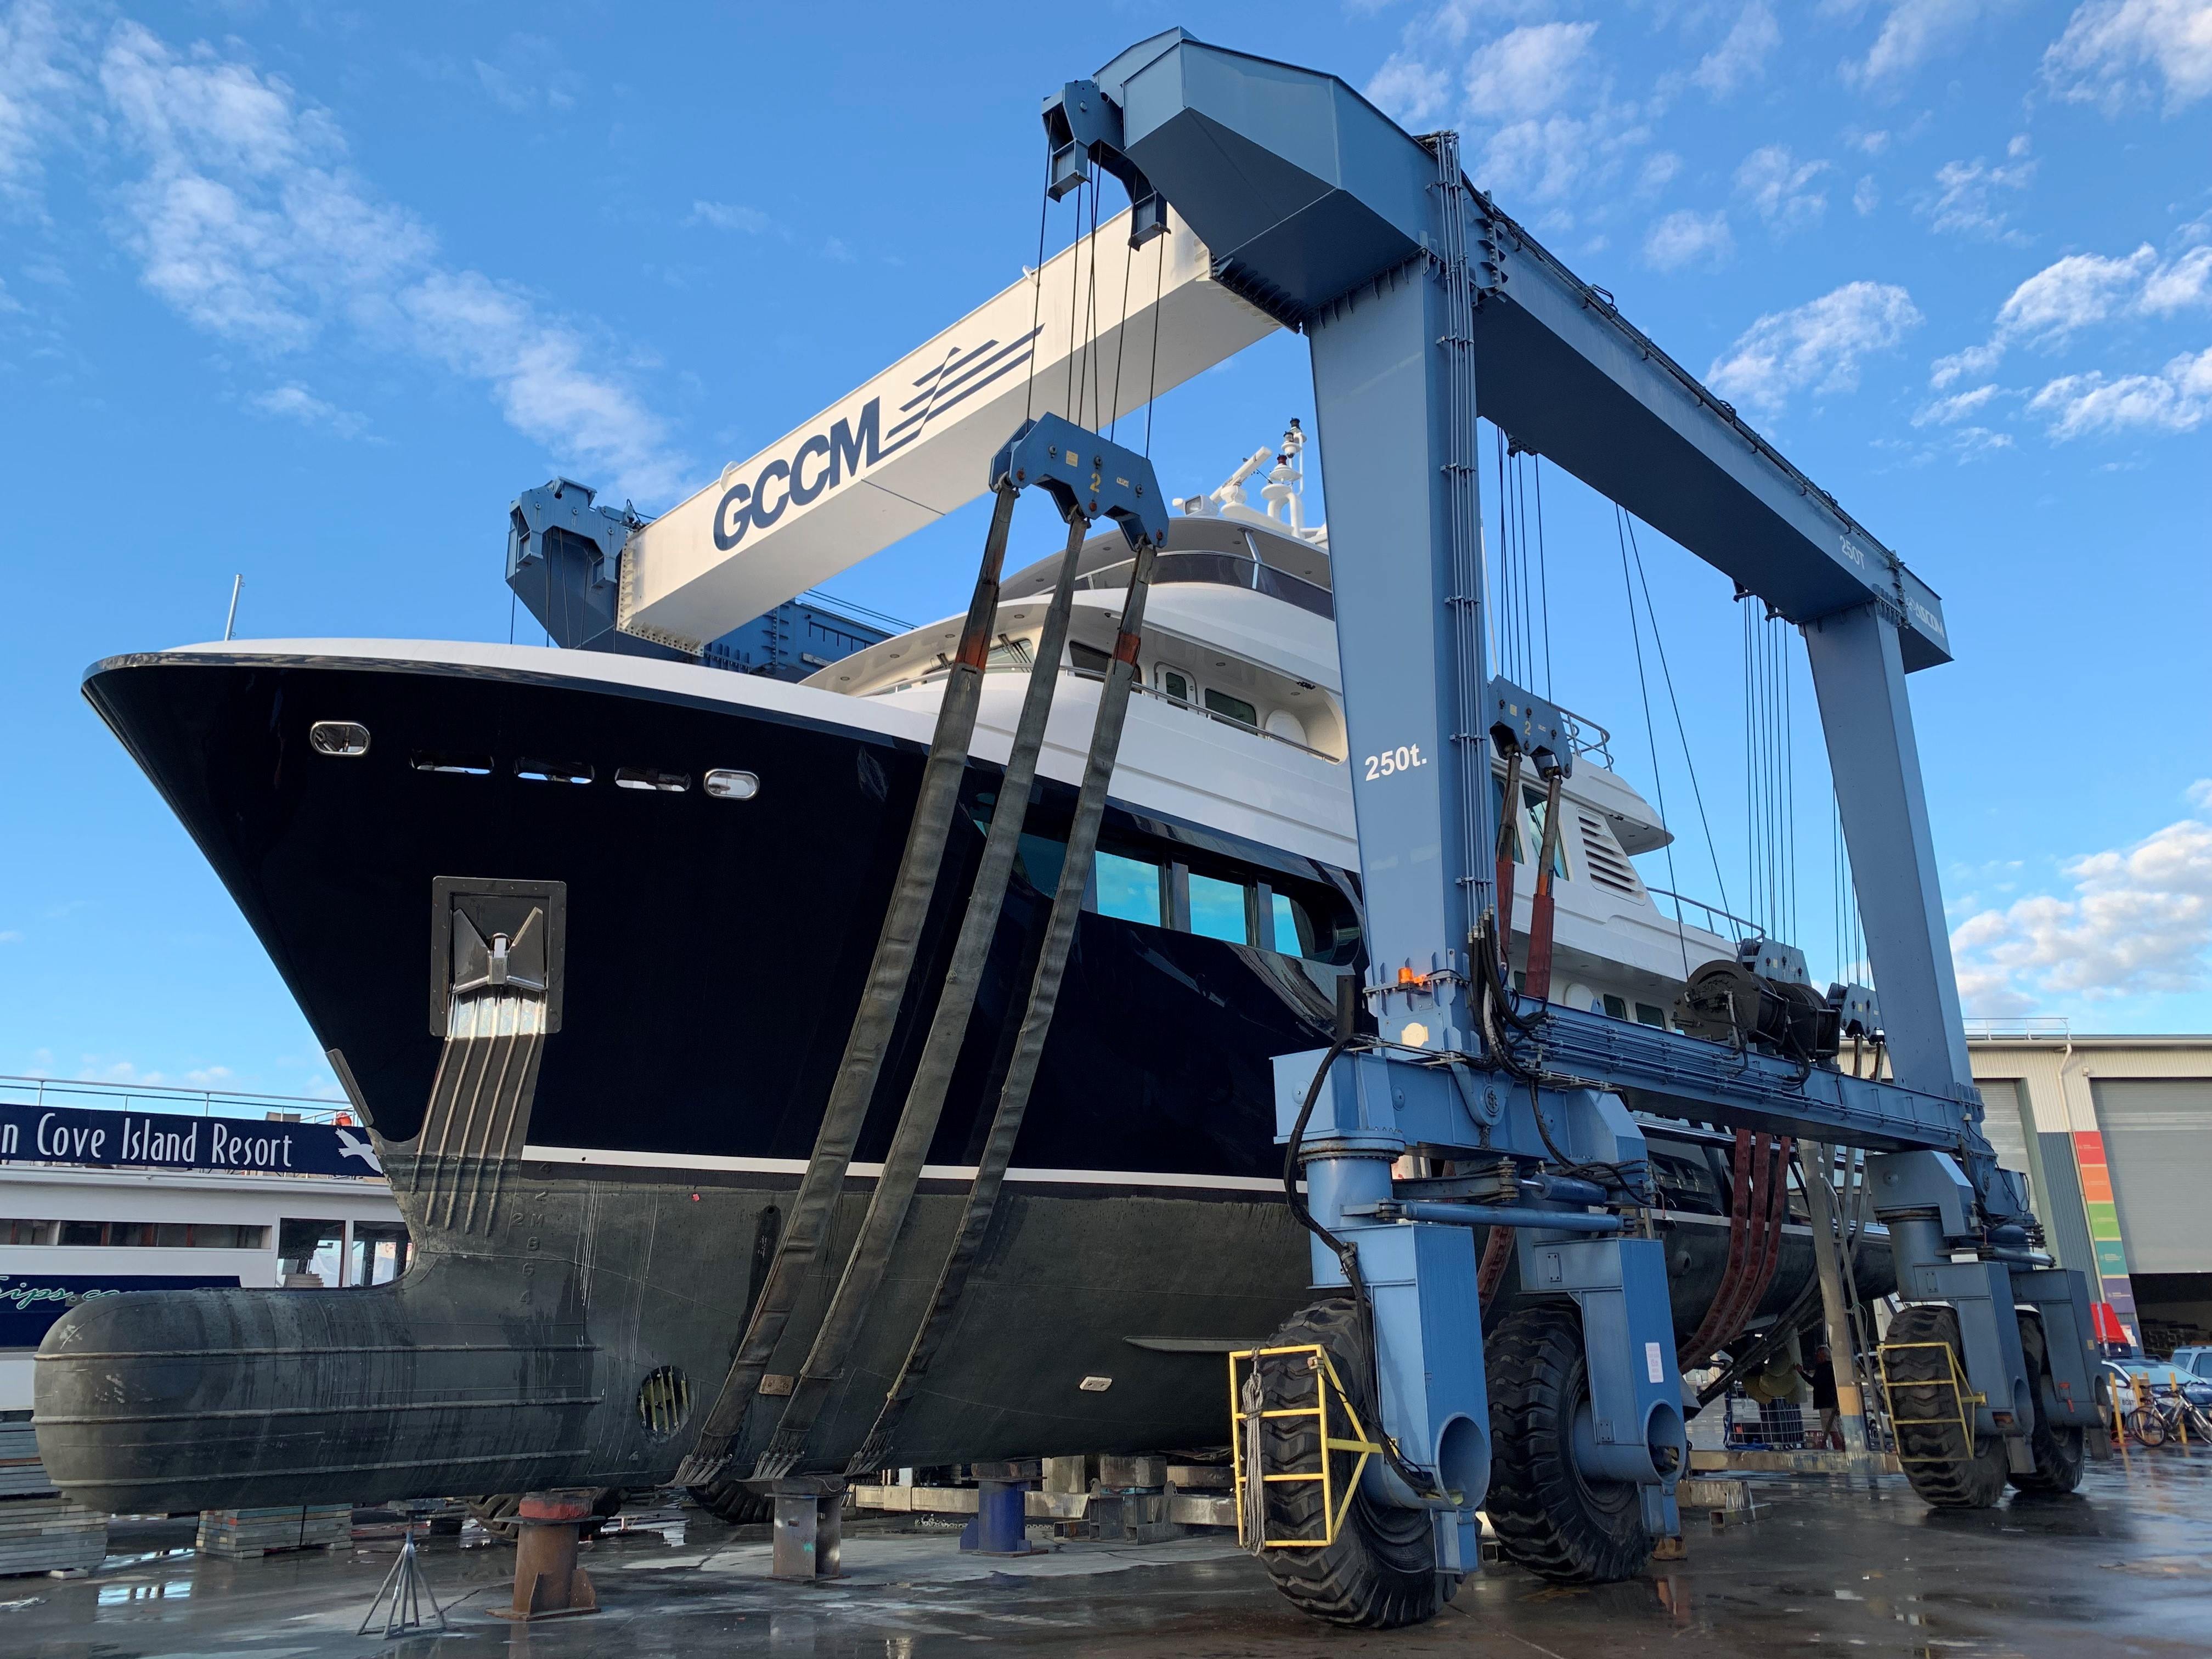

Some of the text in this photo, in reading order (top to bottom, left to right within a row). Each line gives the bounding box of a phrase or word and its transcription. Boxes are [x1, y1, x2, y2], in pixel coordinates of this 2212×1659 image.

[713, 395, 879, 551] GCCM
[1090, 473, 1101, 492] 2
[1839, 534, 1865, 570] 250T
[1524, 720, 1531, 736] 2
[1364, 743, 1427, 781] 250t.
[37, 1113, 105, 1158] Cove
[121, 1117, 197, 1163] Island
[211, 1123, 292, 1167] Resort
